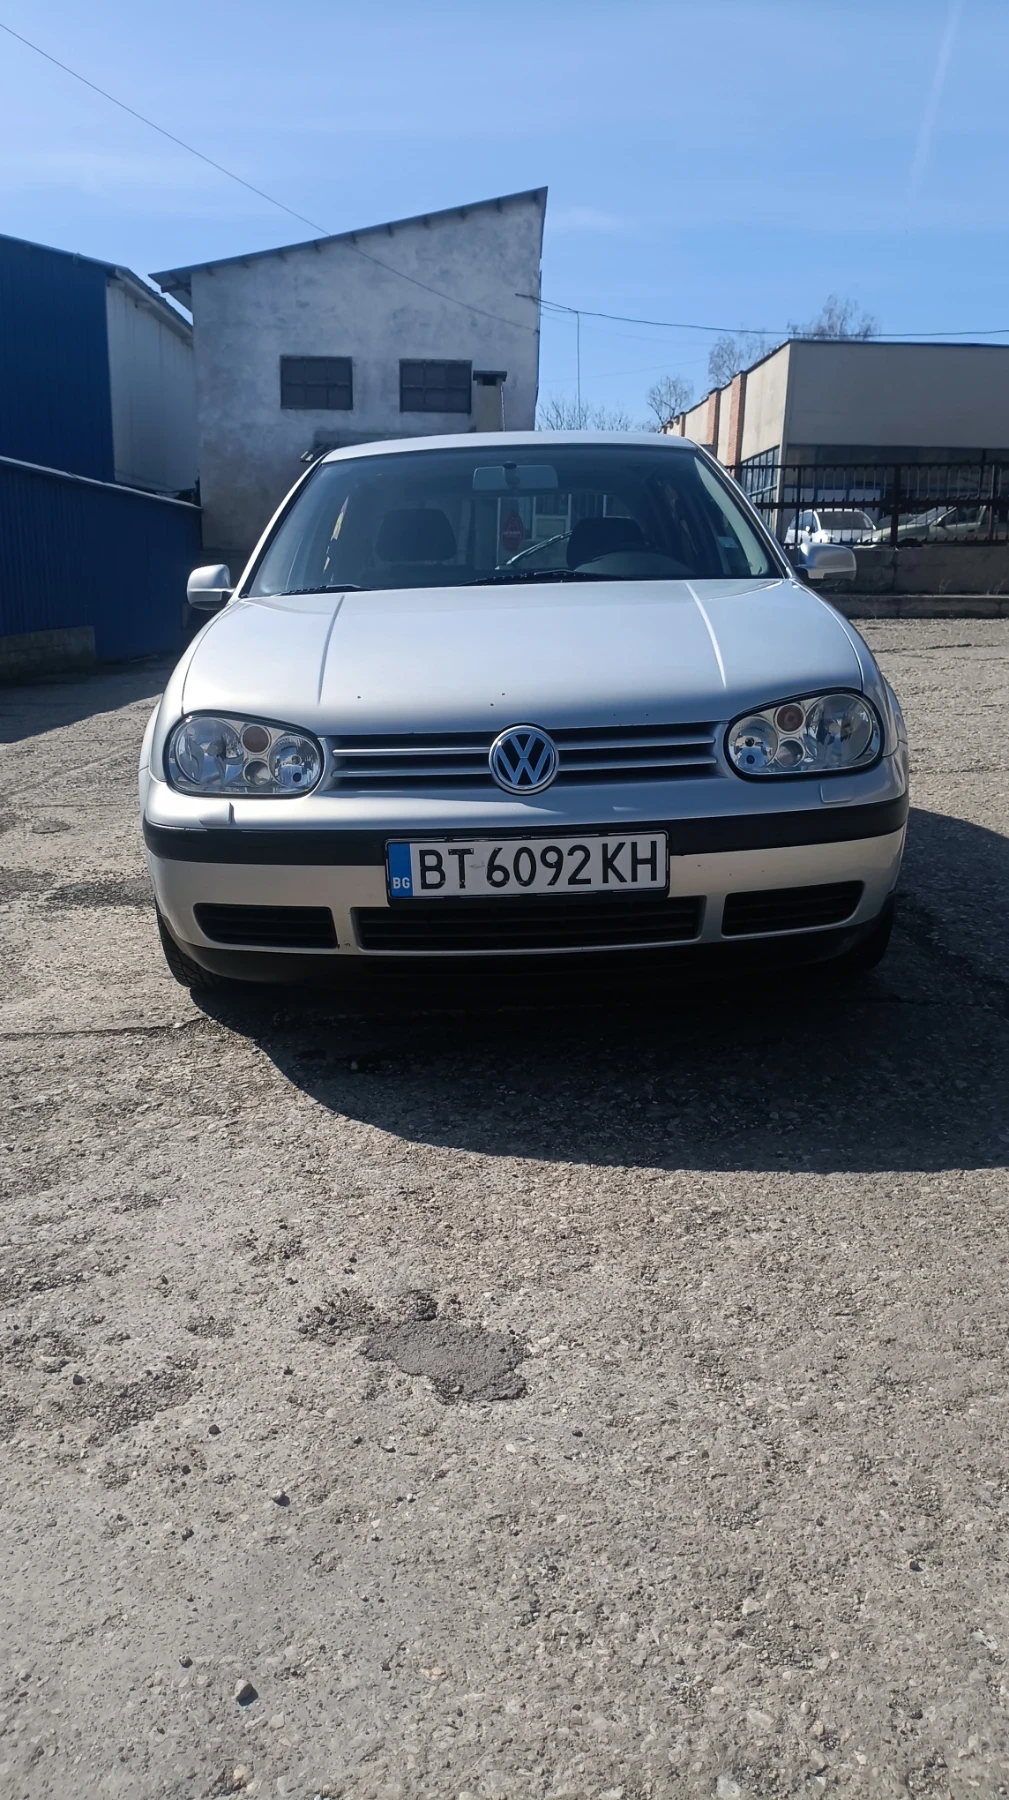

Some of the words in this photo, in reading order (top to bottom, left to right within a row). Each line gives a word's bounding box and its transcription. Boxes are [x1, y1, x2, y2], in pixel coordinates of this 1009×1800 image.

[496, 733, 553, 787] VW
[392, 877, 411, 889] BG
[419, 848, 474, 890] BT
[486, 845, 592, 887] 6092
[602, 841, 657, 884] KH
